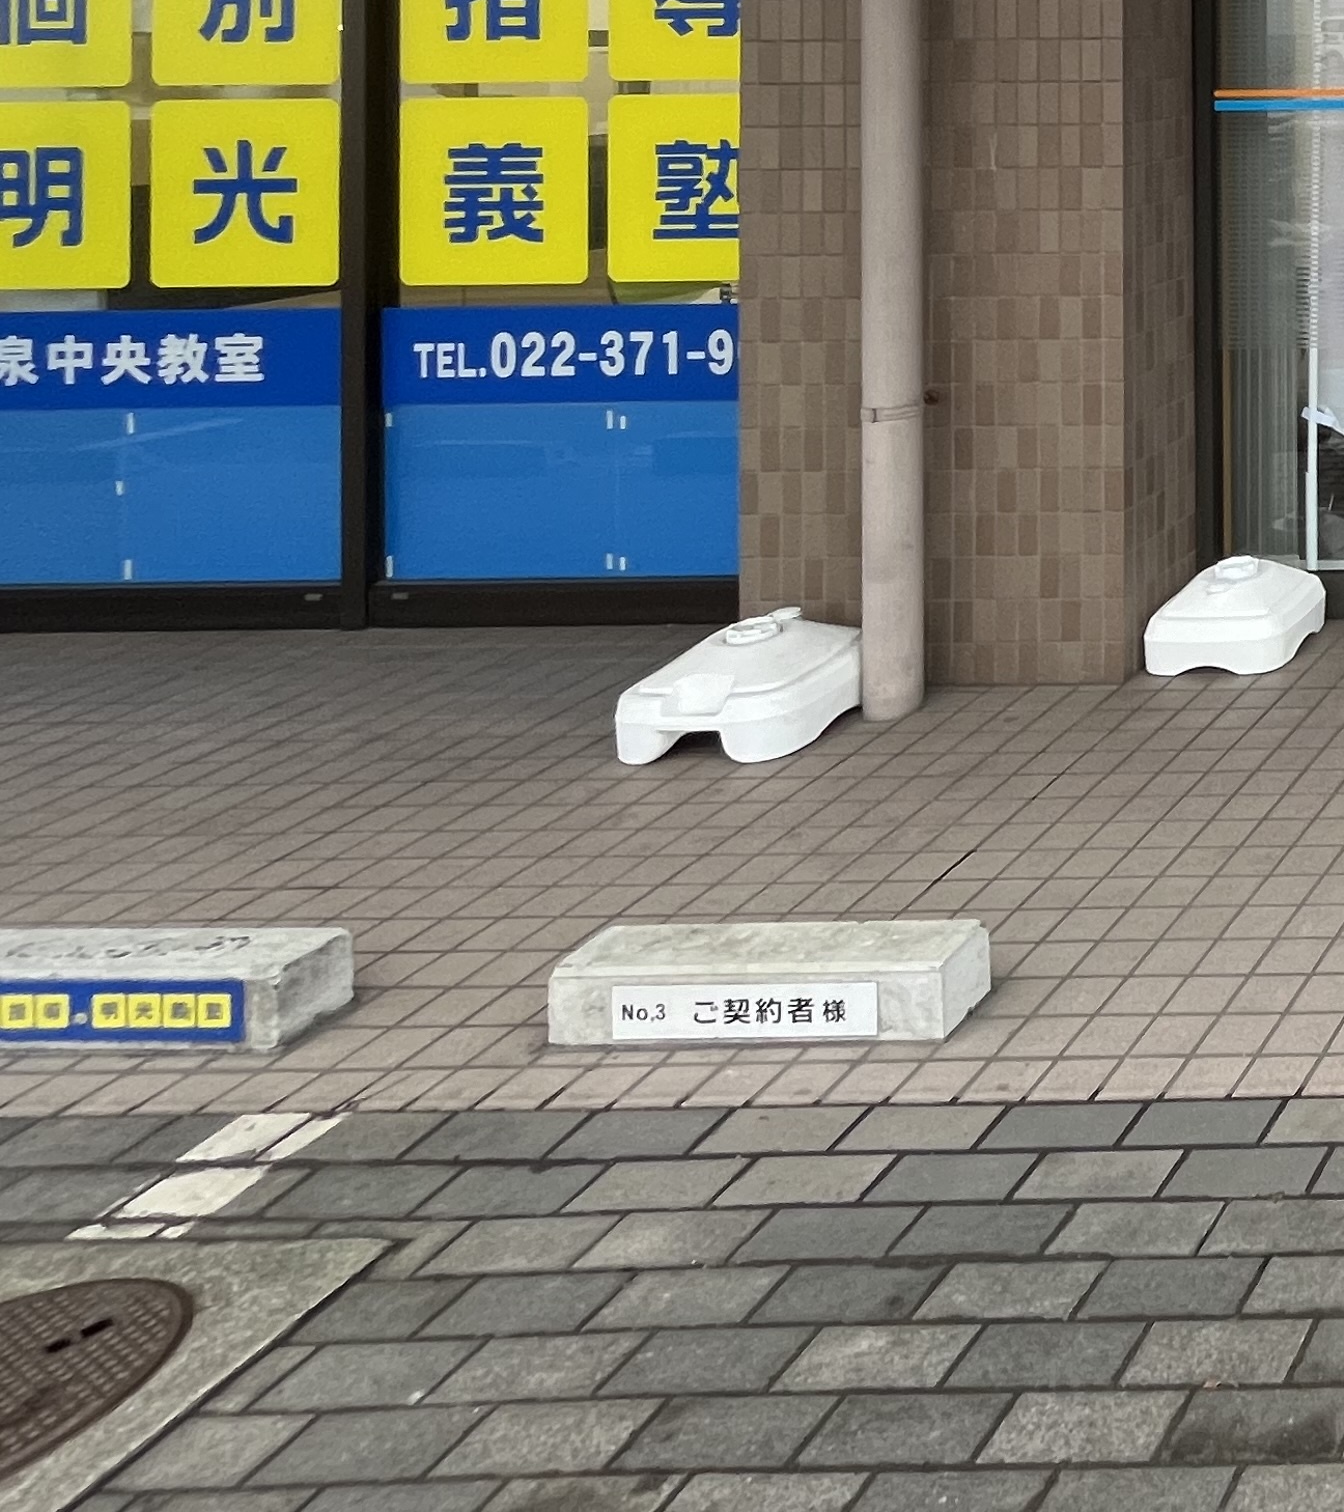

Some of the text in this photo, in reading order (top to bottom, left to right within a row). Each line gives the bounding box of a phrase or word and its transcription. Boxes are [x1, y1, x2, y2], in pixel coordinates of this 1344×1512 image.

[0, 332, 265, 387] 泉中央教室
[694, 997, 848, 1025] ご契約者様
